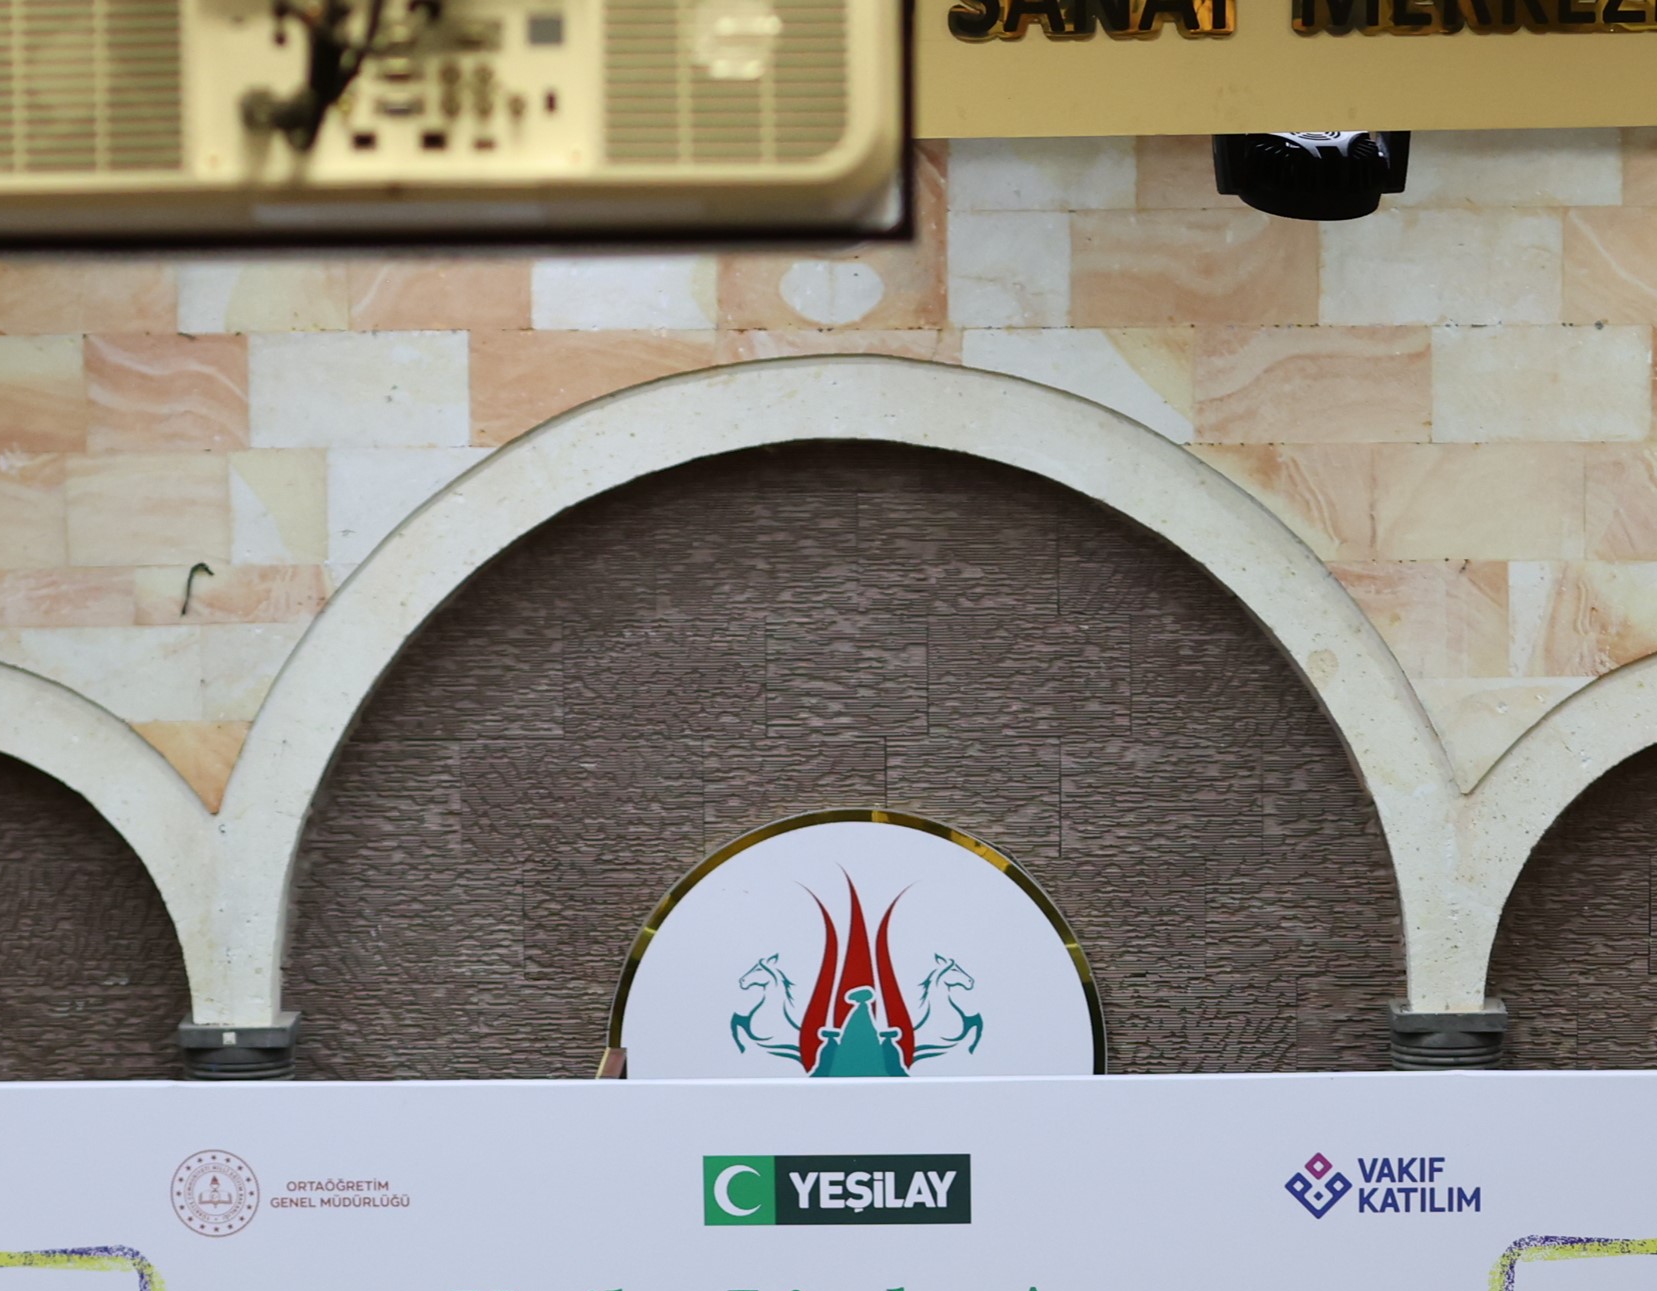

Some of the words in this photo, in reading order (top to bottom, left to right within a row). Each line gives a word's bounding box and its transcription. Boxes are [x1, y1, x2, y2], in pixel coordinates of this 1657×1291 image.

[1358, 1157, 1445, 1183] VAKIF
[286, 1179, 390, 1192] ORTAÖĞRETİM
[270, 1197, 317, 1208] GENEL
[320, 1194, 410, 1208] MÜDÜRLÜĞÜ
[1358, 1187, 1481, 1213] KATILIM
